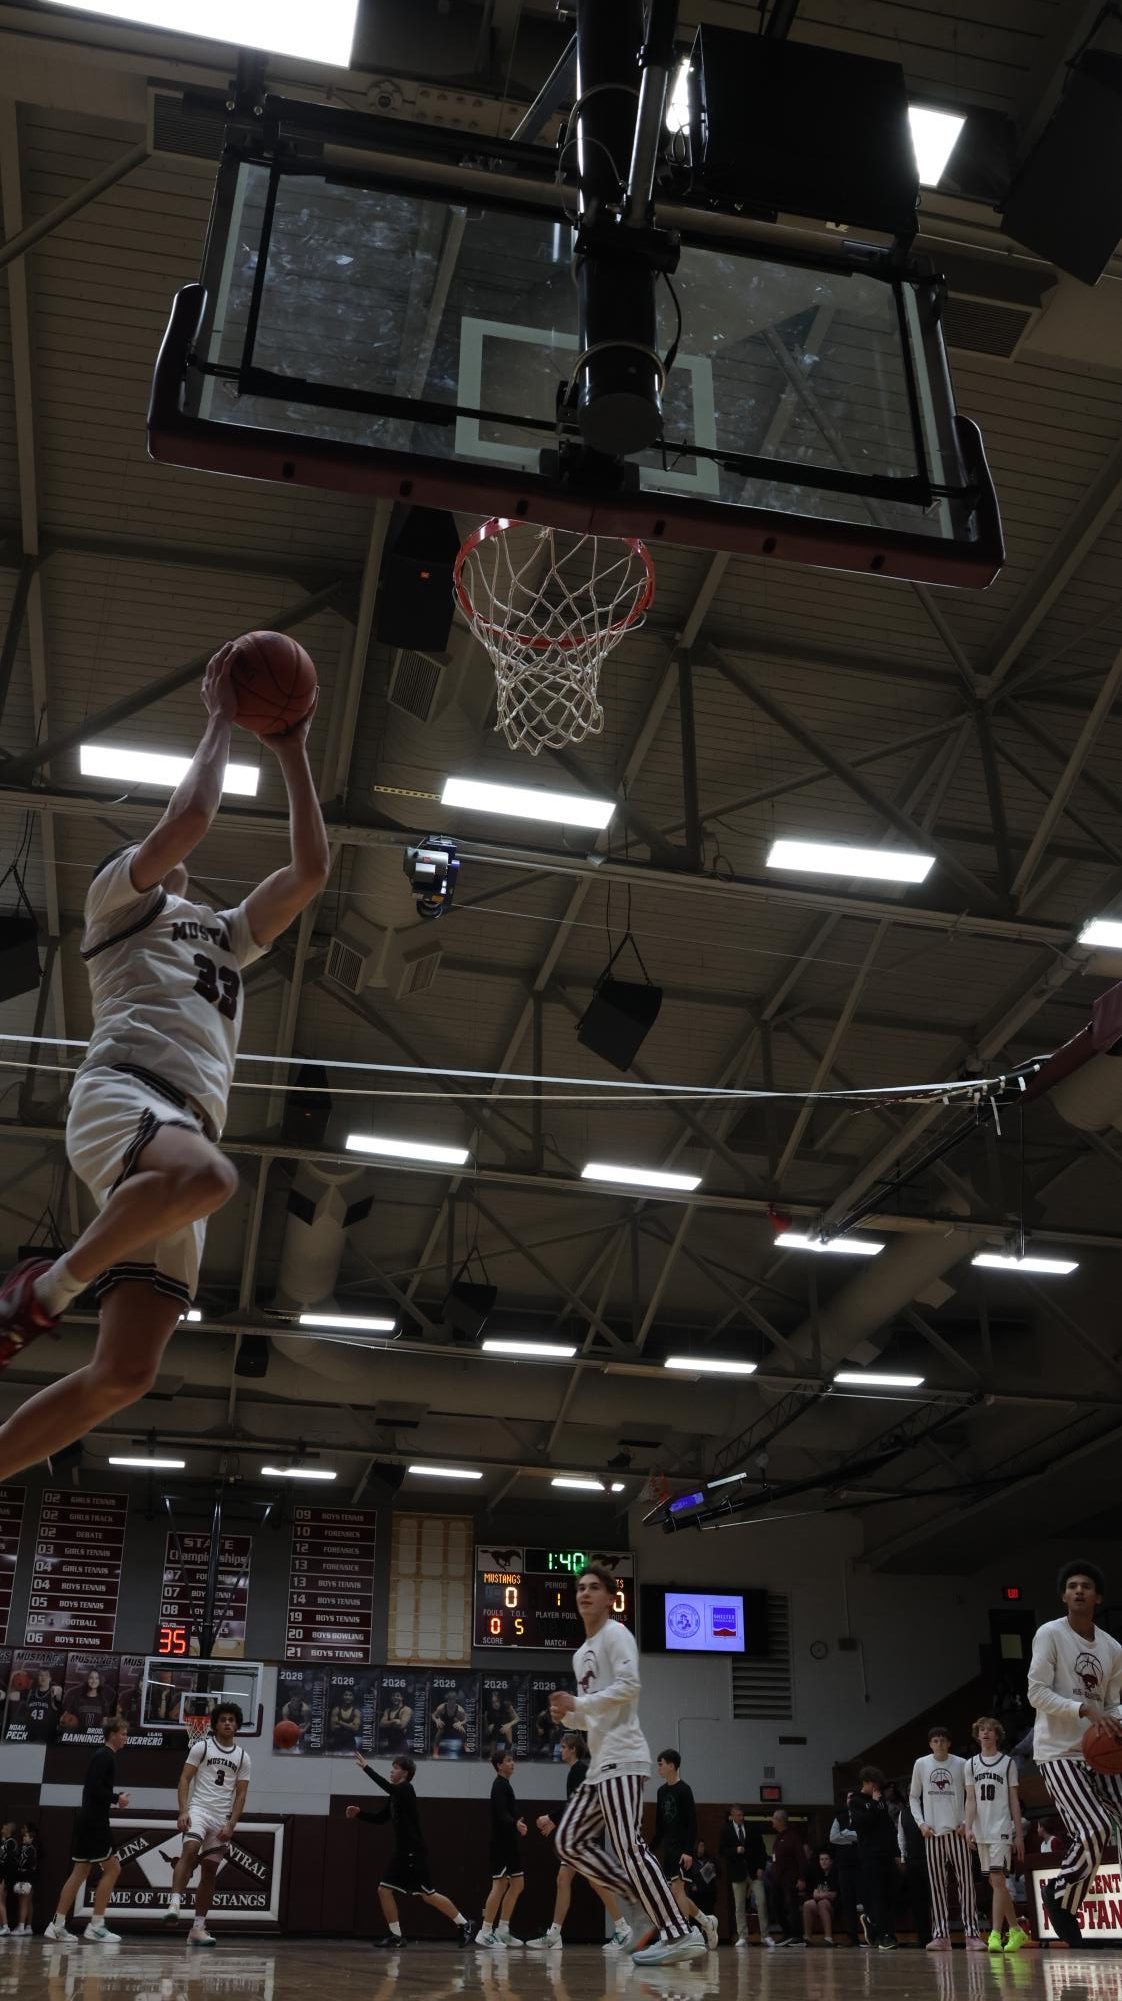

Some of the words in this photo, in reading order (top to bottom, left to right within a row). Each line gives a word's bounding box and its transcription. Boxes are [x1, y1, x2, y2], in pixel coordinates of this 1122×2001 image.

[193, 953, 240, 1021] 33
[45, 1492, 61, 1504] 02
[42, 1509, 59, 1521] 02
[295, 1509, 312, 1521] 09
[40, 1527, 57, 1538] 02
[76, 1530, 104, 1540] DEBATE
[295, 1526, 311, 1537] 10
[183, 1538, 234, 1550] STAE
[295, 1543, 309, 1553] 12
[37, 1544, 54, 1555] 03
[64, 1547, 85, 1556] GIRLS
[86, 1548, 111, 1557] TENNIS
[35, 1561, 52, 1573] 04
[62, 1564, 83, 1573] GIRLS
[84, 1566, 109, 1574] TENNIS
[294, 1560, 308, 1570] 13
[293, 1577, 307, 1588] 13
[318, 1579, 337, 1588] BOYS
[338, 1580, 361, 1589] TENNIS
[483, 1573, 521, 1585] MUSTANGS
[33, 1579, 50, 1590] 04
[61, 1582, 80, 1591] BOYS
[81, 1583, 106, 1592] TENNIS
[545, 1582, 568, 1590] PERIOD
[163, 1586, 181, 1598] 07
[505, 1587, 518, 1608] 0
[31, 1597, 48, 1608] 05
[59, 1600, 78, 1608] BOYS
[79, 1602, 104, 1610] TENNIS
[292, 1594, 307, 1605] 14
[317, 1597, 336, 1605] BOYS
[337, 1598, 361, 1606] TENNIS
[556, 1592, 561, 1606] 1
[162, 1604, 179, 1616] 08
[483, 1609, 503, 1617] FOULS
[535, 1612, 559, 1620] PLAYER
[29, 1614, 47, 1626] 05
[290, 1611, 303, 1622] 19
[315, 1614, 335, 1622] BOYS
[335, 1615, 360, 1624] TENNIS
[490, 1617, 501, 1635] 0
[514, 1618, 524, 1635] 5
[26, 1632, 44, 1644] 06
[54, 1635, 74, 1644] BOYS
[75, 1637, 101, 1646] TENNIS
[288, 1629, 304, 1639] 20
[312, 1631, 331, 1640] BOYS
[331, 1632, 364, 1641] BOWLING
[482, 1637, 503, 1645] SCORE
[158, 1629, 186, 1654] 35
[544, 1639, 567, 1648] MATCH
[287, 1646, 302, 1658] 21
[310, 1649, 333, 1658] BOYS
[334, 1651, 364, 1659] TENNIS
[280, 1671, 303, 1681] 2026
[331, 1676, 355, 1686] 2026
[382, 1679, 407, 1688] 2026
[432, 1679, 457, 1688] 2026
[483, 1681, 509, 1690] 2026
[532, 1682, 557, 1691] 2026
[31, 1710, 44, 1720] 43
[6, 1730, 28, 1741] PECK
[361, 1723, 373, 1752] JULIAN
[413, 1725, 425, 1753] ABRAM
[215, 1769, 226, 1786] 3
[980, 1784, 996, 1801] 10
[116, 1837, 150, 1863] LINA
[134, 1892, 154, 1905] OF
